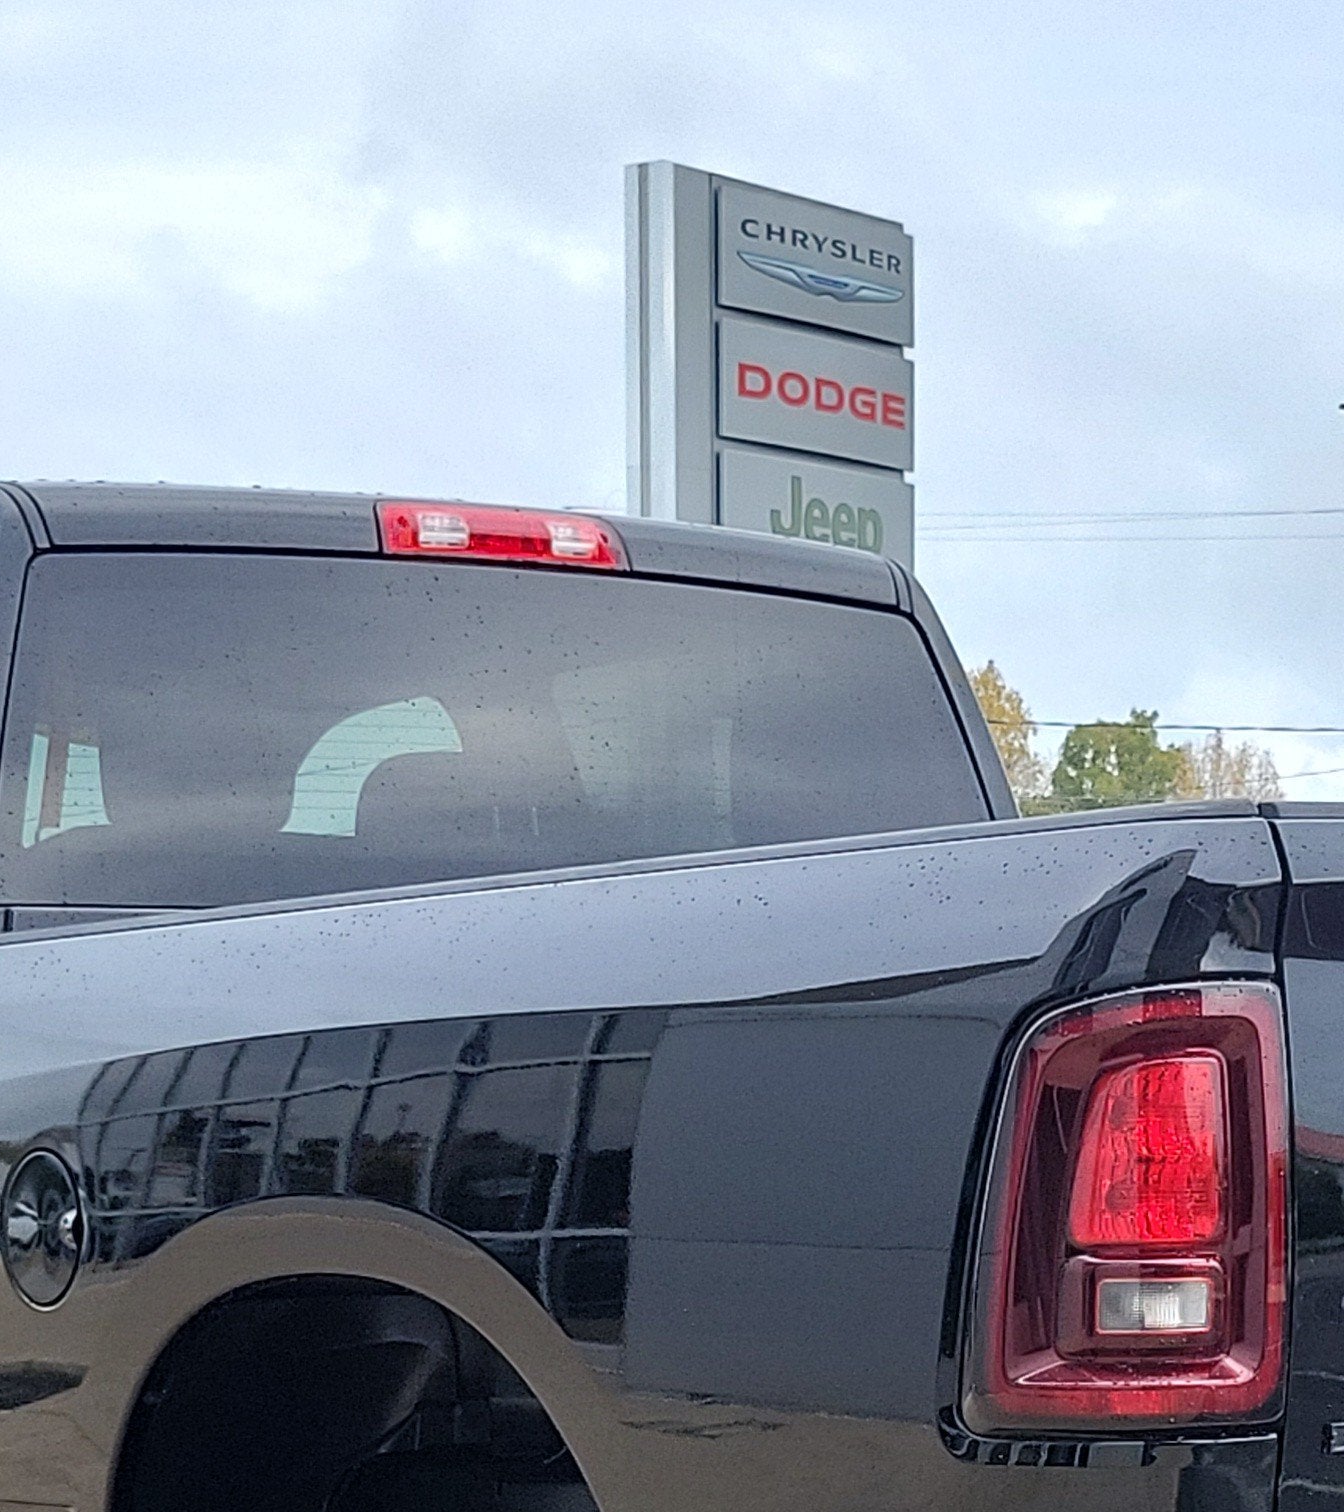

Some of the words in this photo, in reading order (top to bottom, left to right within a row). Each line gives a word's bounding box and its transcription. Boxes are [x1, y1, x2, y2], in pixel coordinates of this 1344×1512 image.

[740, 218, 901, 274] CHRYSLER
[738, 363, 905, 430] DODGE
[770, 475, 884, 553] Jeep
